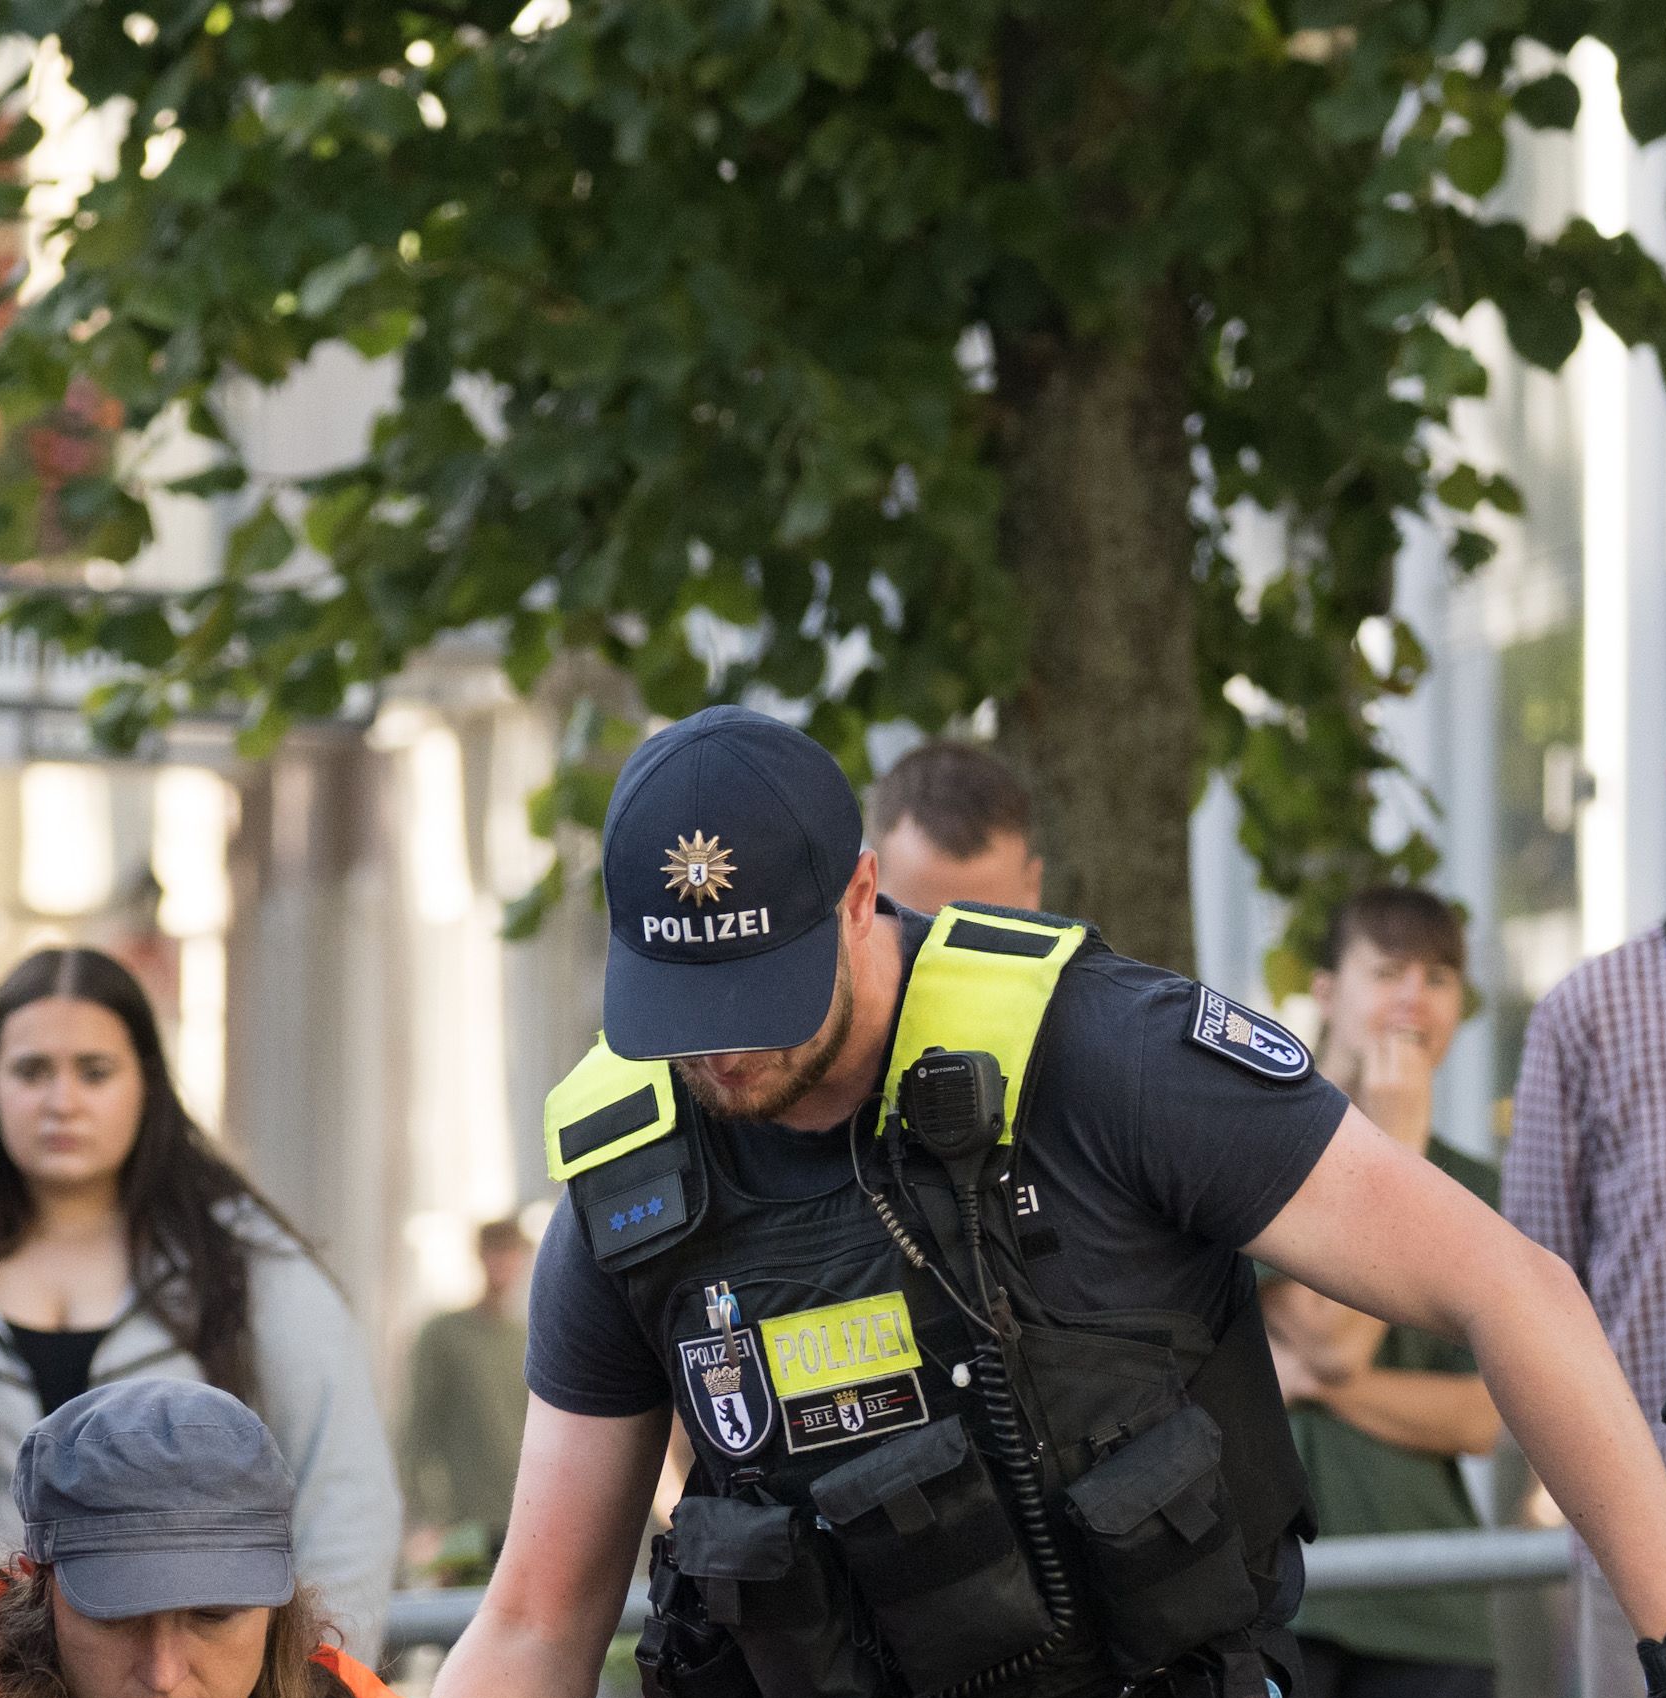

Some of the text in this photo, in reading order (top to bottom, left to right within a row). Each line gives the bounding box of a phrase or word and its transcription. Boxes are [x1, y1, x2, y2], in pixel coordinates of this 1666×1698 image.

[642, 907, 770, 943] POLIZEI
[1201, 993, 1226, 1045] POLIZEI
[928, 1064, 966, 1075] MOTOROLA
[774, 1310, 910, 1381] POLIZEI
[802, 1397, 890, 1429] BFE BE
